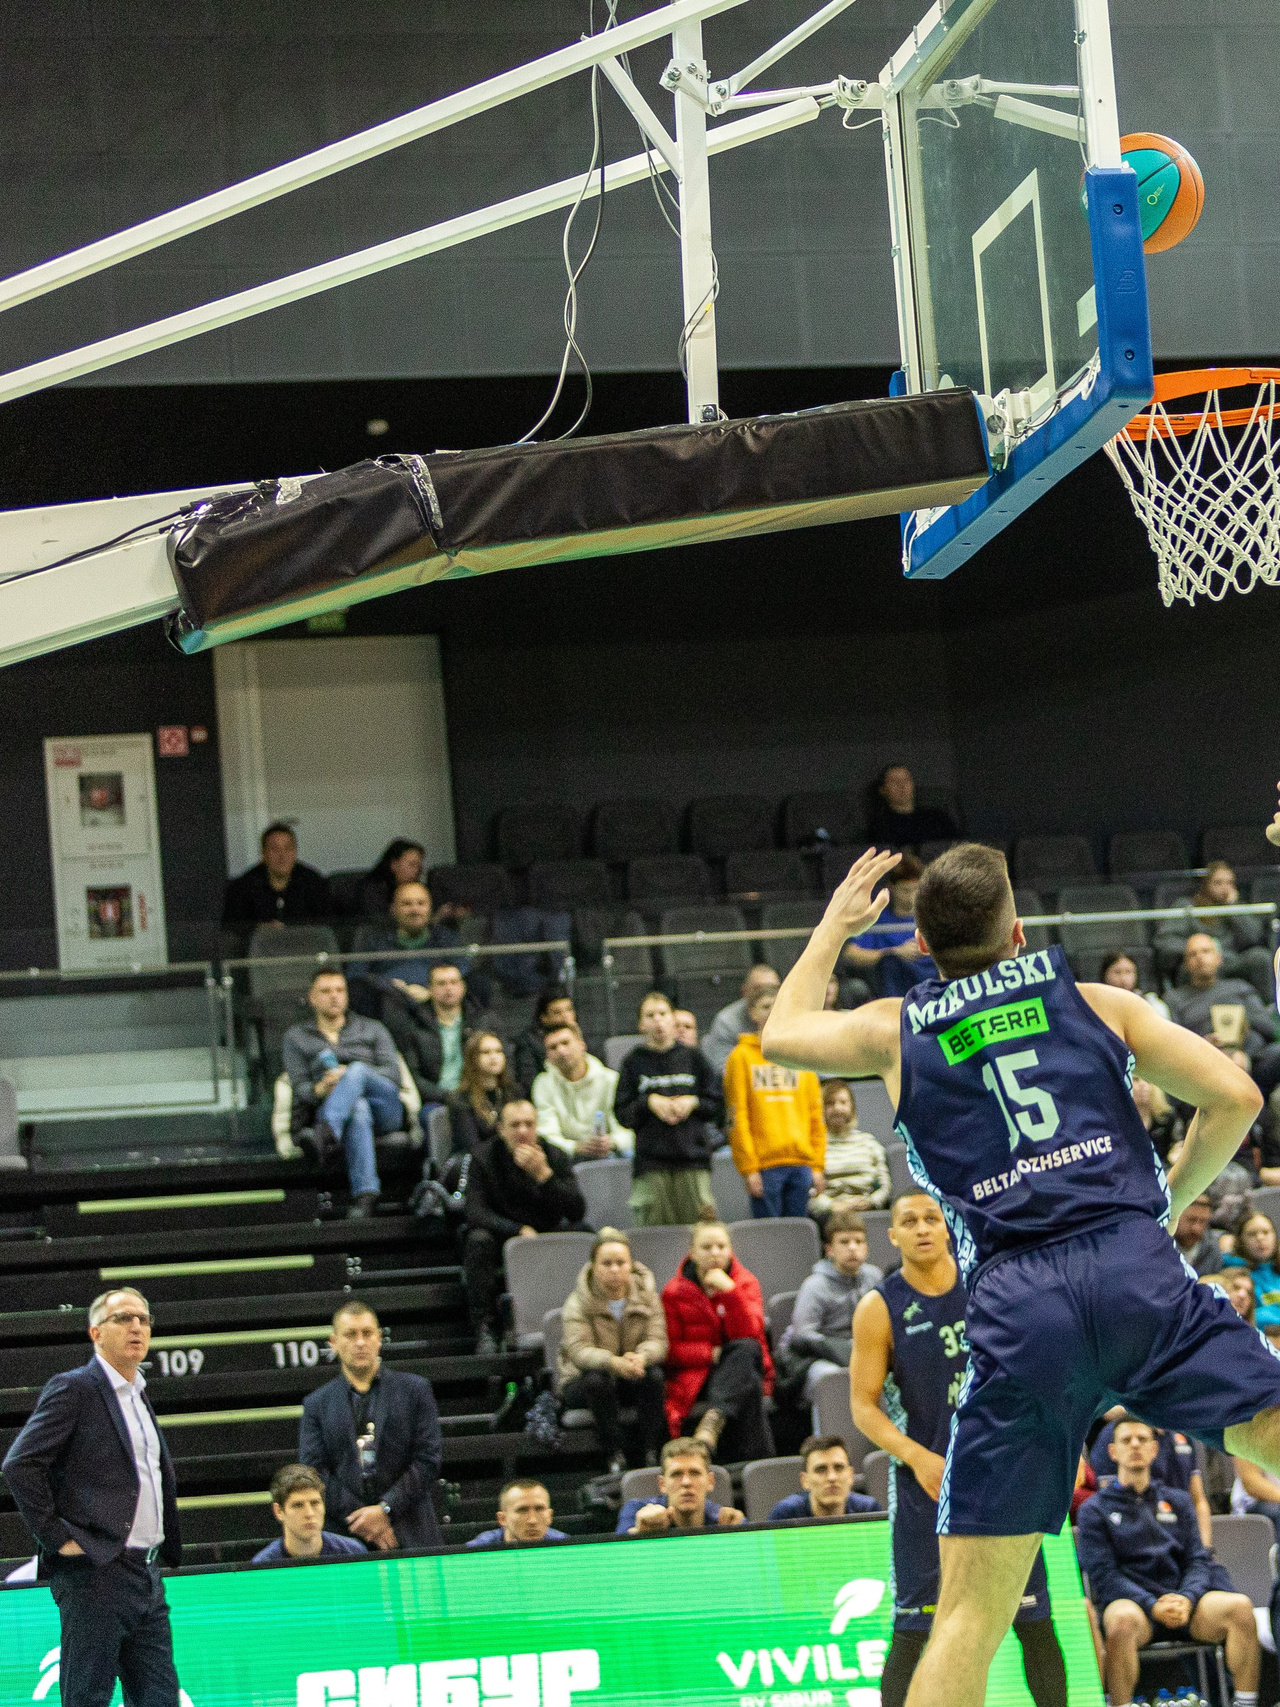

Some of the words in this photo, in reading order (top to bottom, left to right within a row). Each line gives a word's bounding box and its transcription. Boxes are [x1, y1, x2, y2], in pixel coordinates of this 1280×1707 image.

[907, 949, 1056, 1035] MIKULSKI
[948, 1007, 1041, 1055] BETERA
[982, 1049, 1060, 1152] 15
[972, 1135, 1113, 1201] BELTAOZHSERVICE
[158, 1349, 204, 1377] 109
[272, 1340, 319, 1368] 110
[296, 1648, 600, 1707] СИБУР
[716, 1639, 888, 1690] VIVILE
